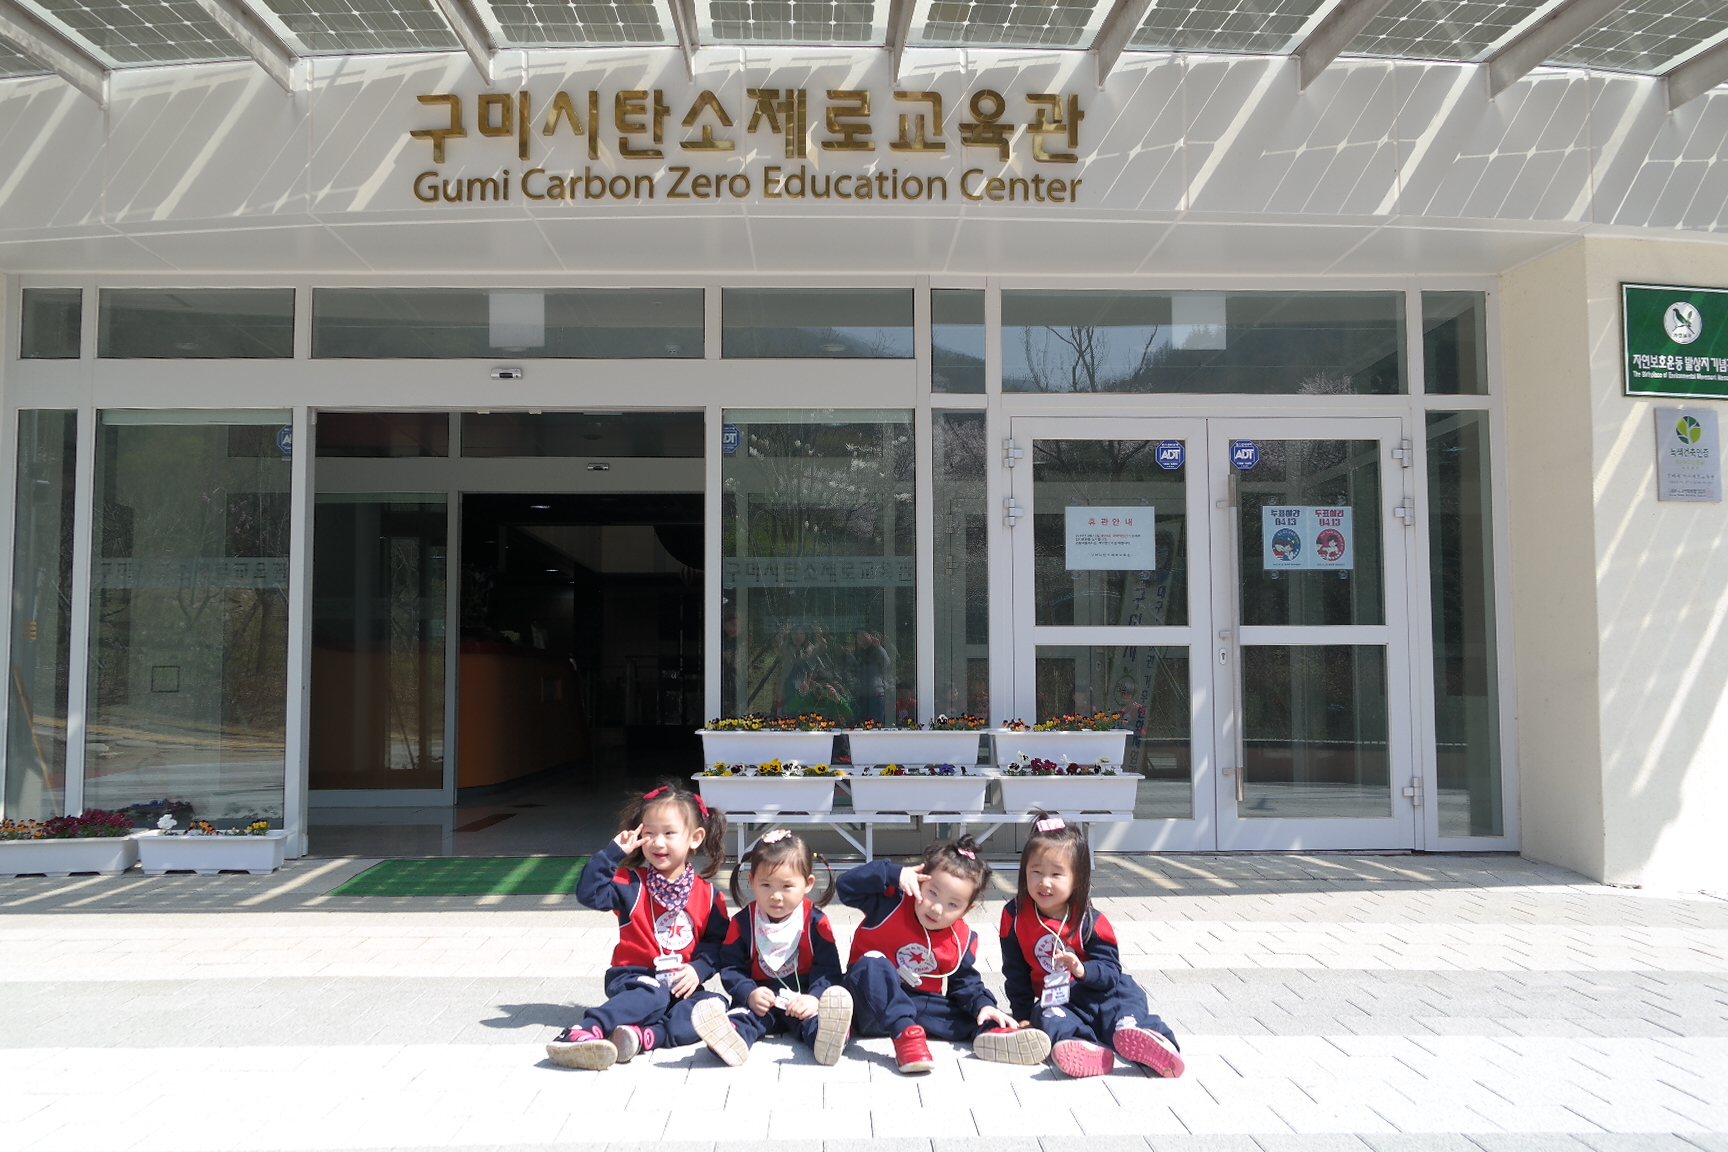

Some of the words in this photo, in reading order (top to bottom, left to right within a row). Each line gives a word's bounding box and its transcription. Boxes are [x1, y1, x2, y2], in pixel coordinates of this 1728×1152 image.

[410, 89, 1085, 163] 구미시탄소제로교육관
[413, 169, 510, 203] Gumi
[520, 165, 654, 201] Carbon
[667, 166, 751, 201] Zero
[763, 165, 948, 201] Education
[960, 167, 1083, 203] Center
[1632, 354, 1684, 371] 자연보호운동
[1684, 356, 1710, 372] 발상지
[1710, 357, 1728, 373] 기념
[723, 433, 737, 444] DT
[1160, 449, 1181, 460] ADT
[1234, 449, 1255, 460] ADT
